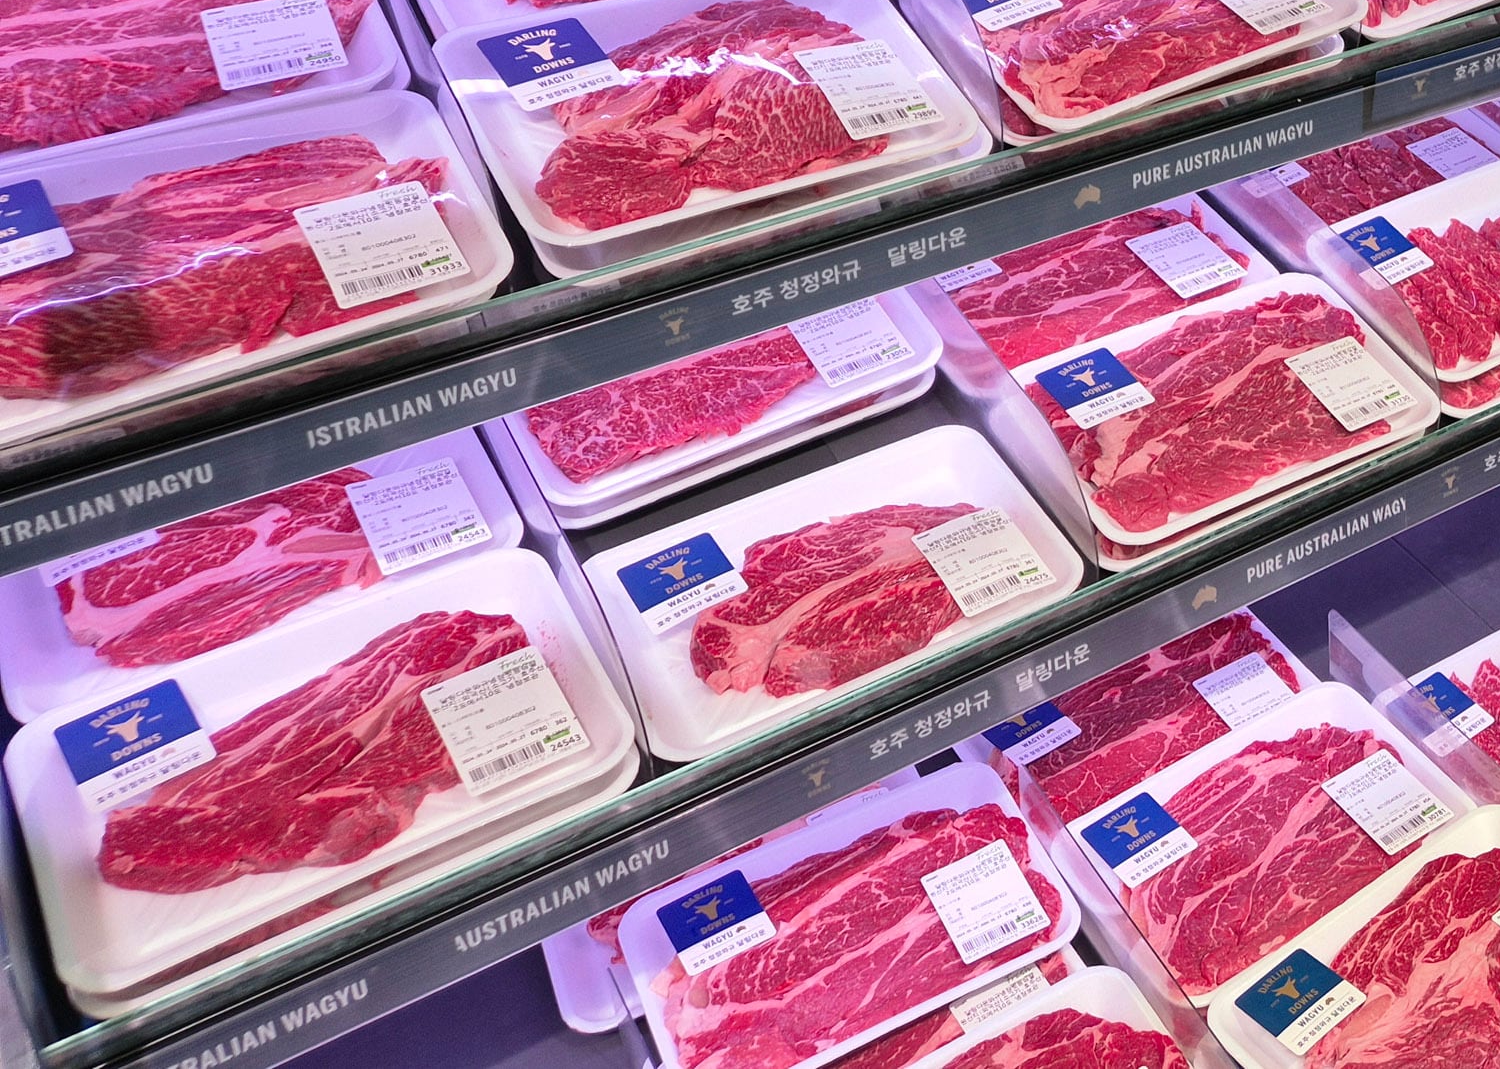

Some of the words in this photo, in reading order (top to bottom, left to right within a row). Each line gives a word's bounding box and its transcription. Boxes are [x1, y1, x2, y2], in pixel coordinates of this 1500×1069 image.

[507, 27, 558, 47] DARLING
[532, 56, 576, 75] DOWNS
[1453, 61, 1480, 82] 호주
[537, 72, 574, 89] WAGYU
[913, 108, 938, 120] 29899
[1132, 155, 1171, 189] PURE
[1174, 134, 1264, 179] AUSTRALIAN
[1265, 119, 1315, 148] WAGYU
[430, 261, 463, 276] 31933
[731, 286, 775, 316] 호주
[779, 259, 861, 302] 청정와규
[887, 227, 967, 268] 달링다운
[1057, 357, 1095, 377] DARLING
[436, 367, 518, 409] WAGYU
[1081, 381, 1114, 398] DOWNS
[1087, 394, 1116, 410] WAGYU
[119, 463, 214, 504] WAGYU
[458, 527, 487, 542] 24543
[644, 545, 691, 570] DARLING
[1245, 552, 1284, 583] PURE
[1286, 512, 1371, 567] AUSTRALIAN
[665, 573, 705, 595] DOWNS
[1023, 572, 1050, 585] 24475
[666, 588, 702, 608] WAGYU
[868, 727, 910, 761] 호주
[914, 689, 992, 738] 청정와규
[1014, 643, 1091, 693] 달링다운
[1015, 720, 1044, 740] DOWNS
[1022, 732, 1047, 748] WAGYU
[549, 734, 583, 753] 24543
[1101, 805, 1138, 830] DARLING
[1125, 830, 1158, 852] DOWNS
[594, 839, 670, 888] WAGYU
[1132, 845, 1160, 865] WAGYU
[681, 883, 724, 909] DARLING
[699, 912, 737, 936] DOWNS
[701, 929, 735, 950] WAGYU
[1258, 964, 1294, 996] DARLING
[280, 978, 370, 1032] WAGYU
[1287, 987, 1320, 1015] DOWNS
[1297, 1003, 1325, 1028] WAGYU
